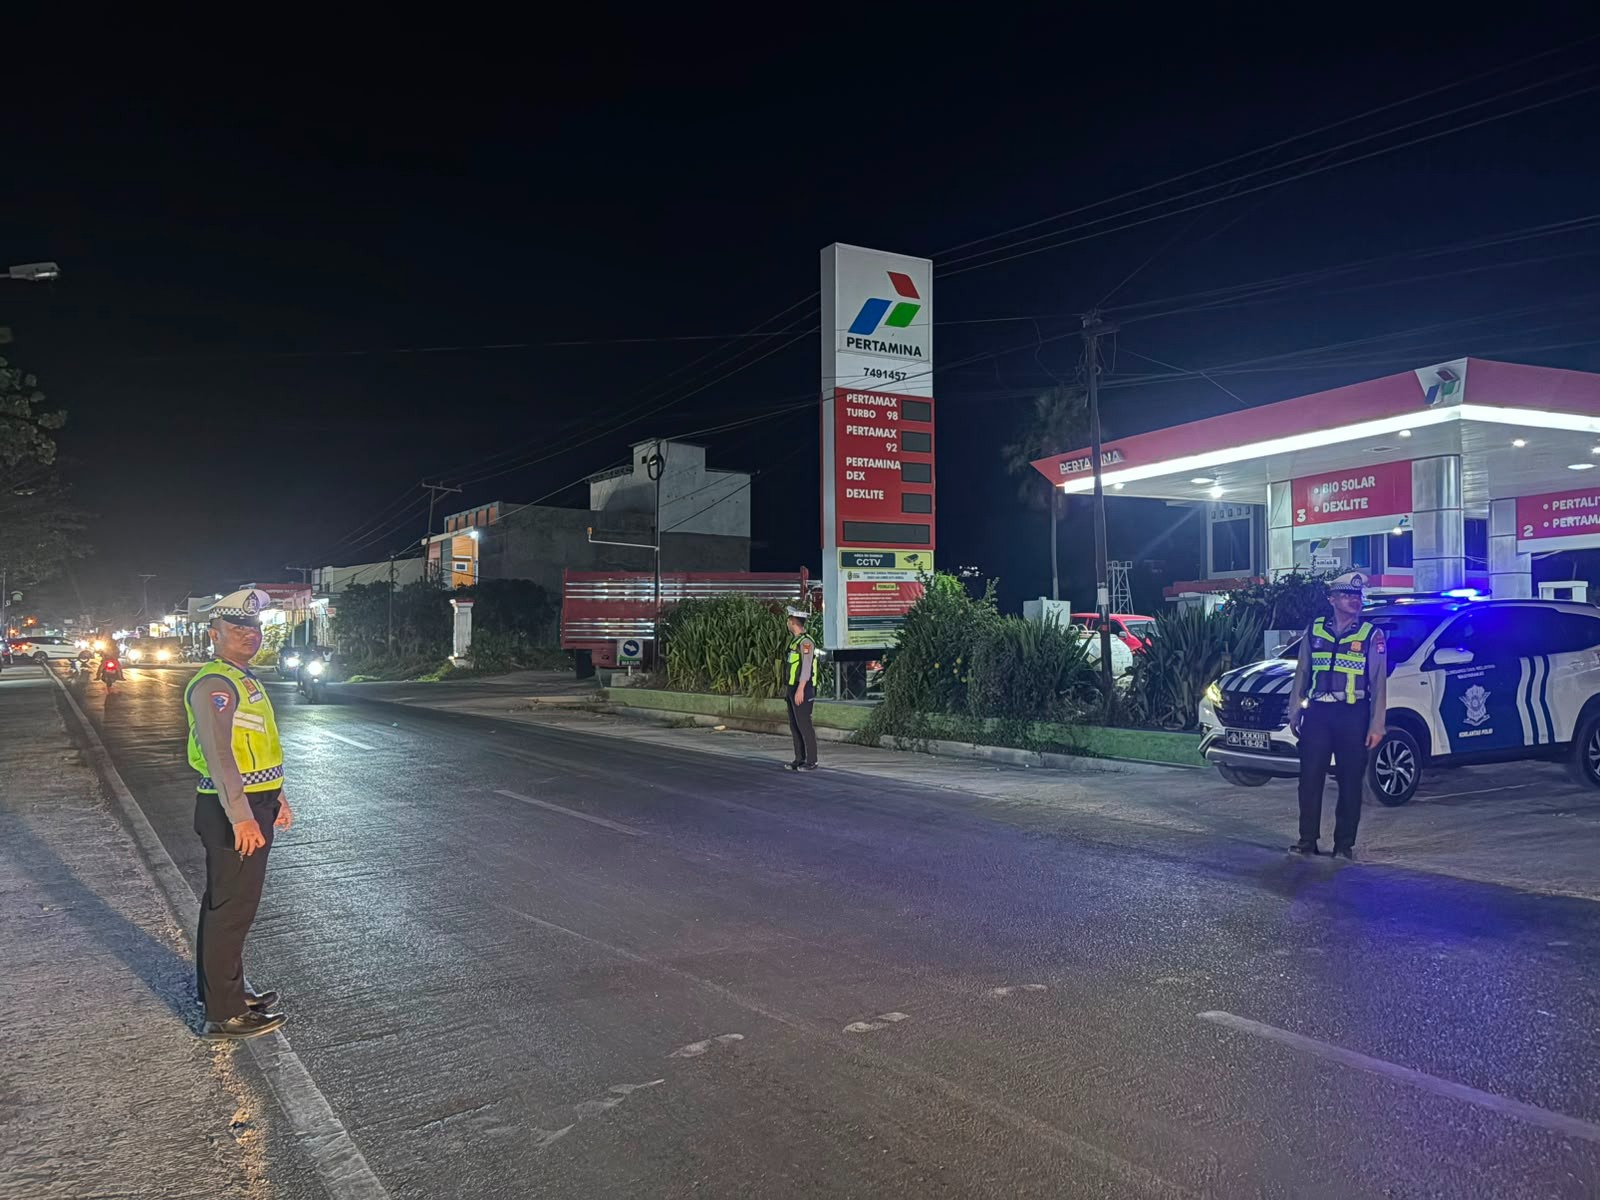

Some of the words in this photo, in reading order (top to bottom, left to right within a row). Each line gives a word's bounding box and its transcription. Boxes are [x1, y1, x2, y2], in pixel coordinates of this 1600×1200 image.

[846, 336, 922, 357] PERTAMINA
[863, 367, 907, 381] 7491457
[846, 393, 897, 407] PERTAMAX
[846, 407, 876, 419] TURBO
[886, 411, 899, 421] 98
[846, 425, 897, 439] PERTAMAX
[886, 443, 898, 453] 92
[846, 457, 902, 470] PERTAMINA
[1060, 450, 1124, 475] PERTAINA
[846, 471, 866, 481] DEX
[1322, 481, 1340, 494] BIO
[1341, 476, 1376, 491] SOLAR
[846, 488, 884, 500] DEXLITE
[1322, 497, 1369, 513] DEXLITE
[1296, 508, 1306, 522] 3
[1523, 524, 1534, 537] 2
[856, 558, 881, 567] CCTV
